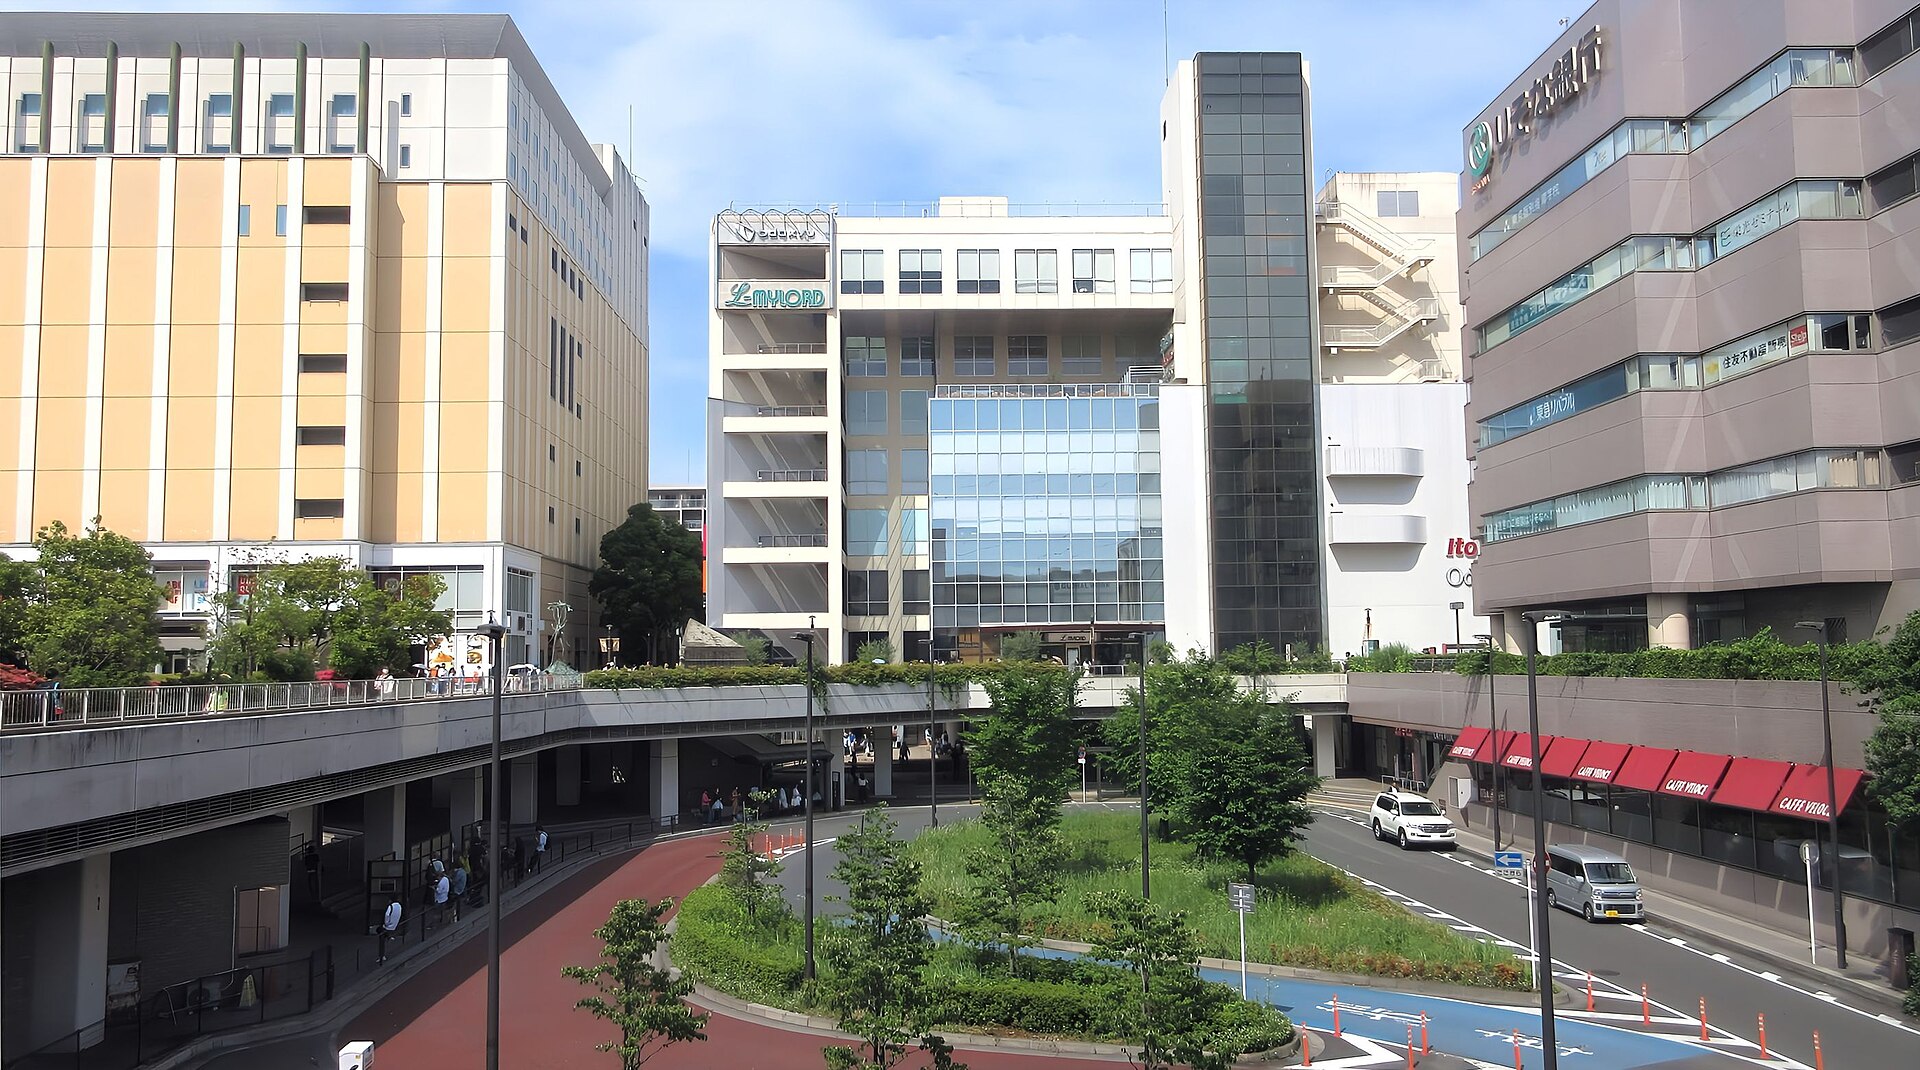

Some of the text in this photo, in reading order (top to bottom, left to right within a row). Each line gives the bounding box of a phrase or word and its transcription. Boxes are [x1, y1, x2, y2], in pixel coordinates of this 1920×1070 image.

[1536, 392, 1575, 420] 東急リバブル
